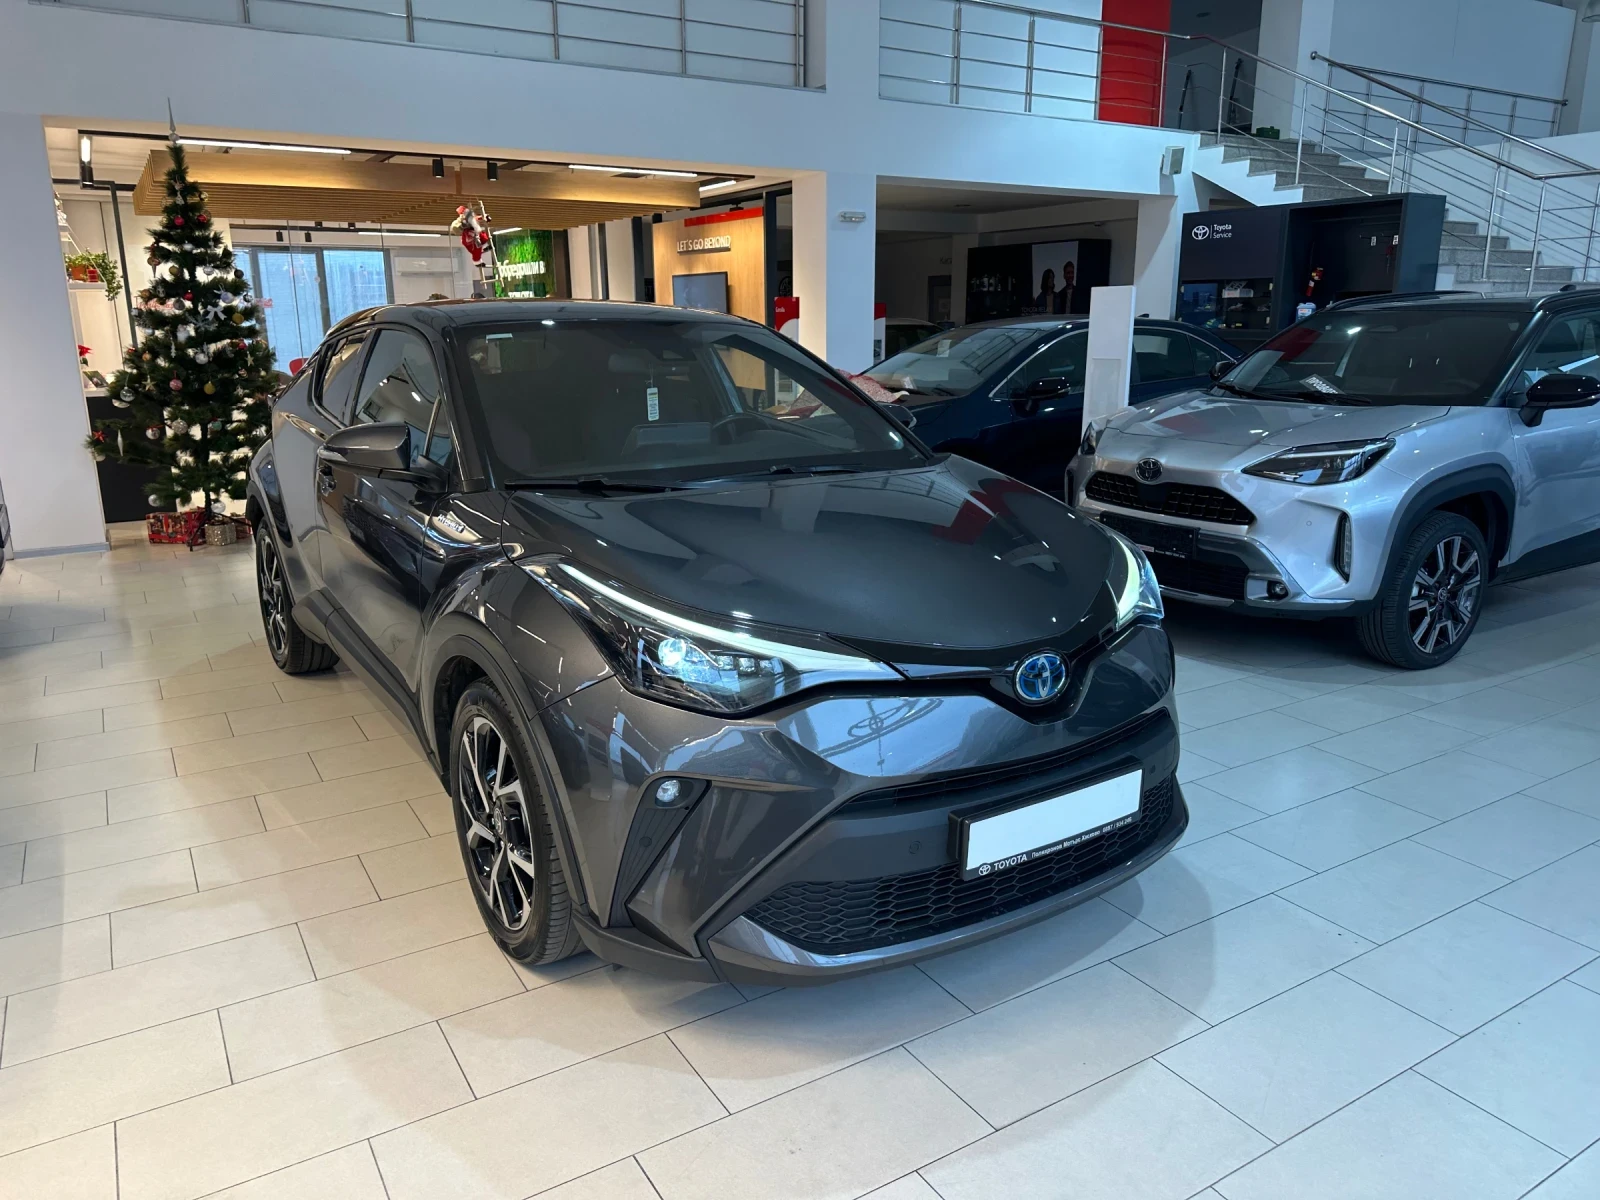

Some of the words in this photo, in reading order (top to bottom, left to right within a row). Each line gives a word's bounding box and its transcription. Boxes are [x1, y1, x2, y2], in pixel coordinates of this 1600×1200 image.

[1213, 224, 1232, 232] Toyota
[693, 238, 704, 250] GO
[704, 235, 731, 249] BEYOND
[993, 853, 1028, 871] TOYOTA
